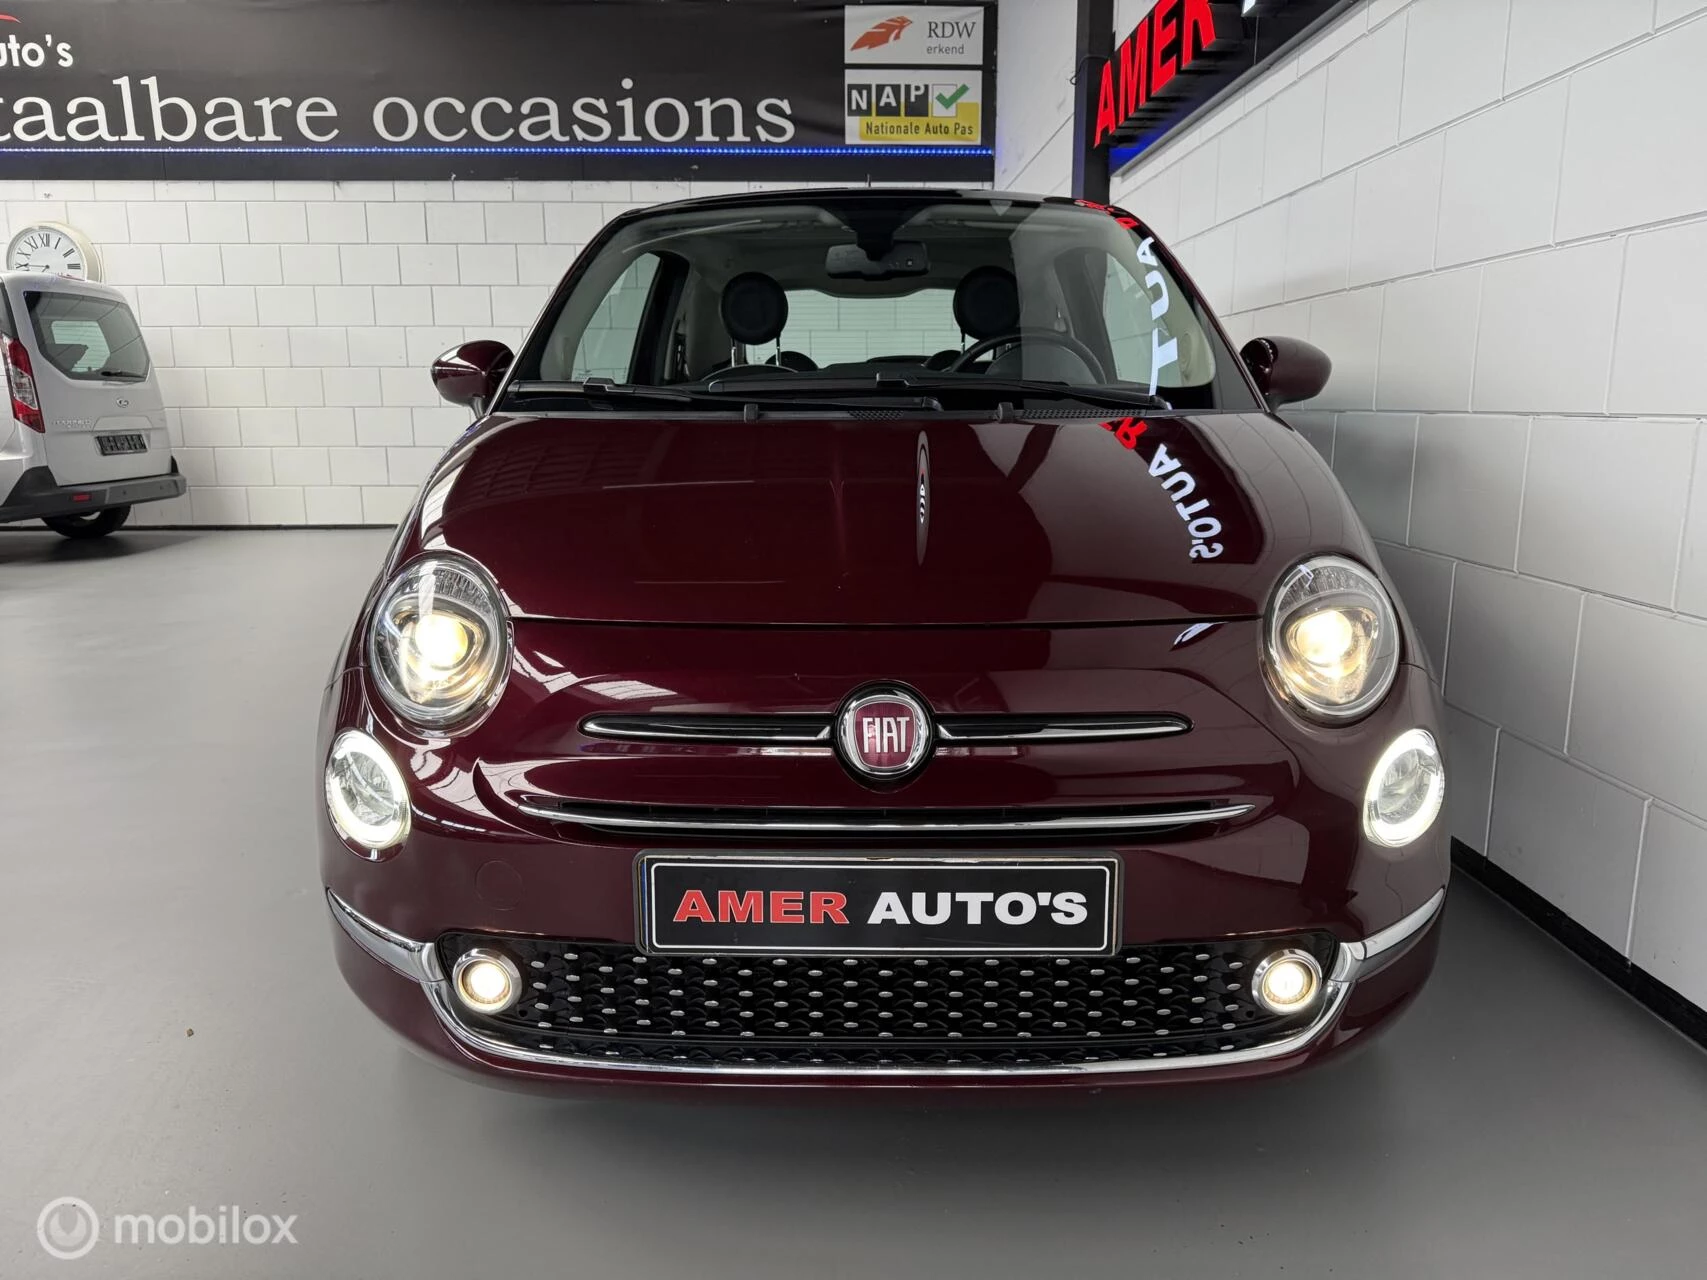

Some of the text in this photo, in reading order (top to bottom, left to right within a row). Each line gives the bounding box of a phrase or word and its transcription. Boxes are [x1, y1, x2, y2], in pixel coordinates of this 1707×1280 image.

[928, 22, 976, 38] RDW
[926, 44, 964, 55] erkend
[372, 78, 796, 143] occasions
[866, 122, 973, 135] Nationale Auto Pas
[862, 716, 910, 753] FIAT
[673, 889, 1088, 925] AMER AUTO'S
